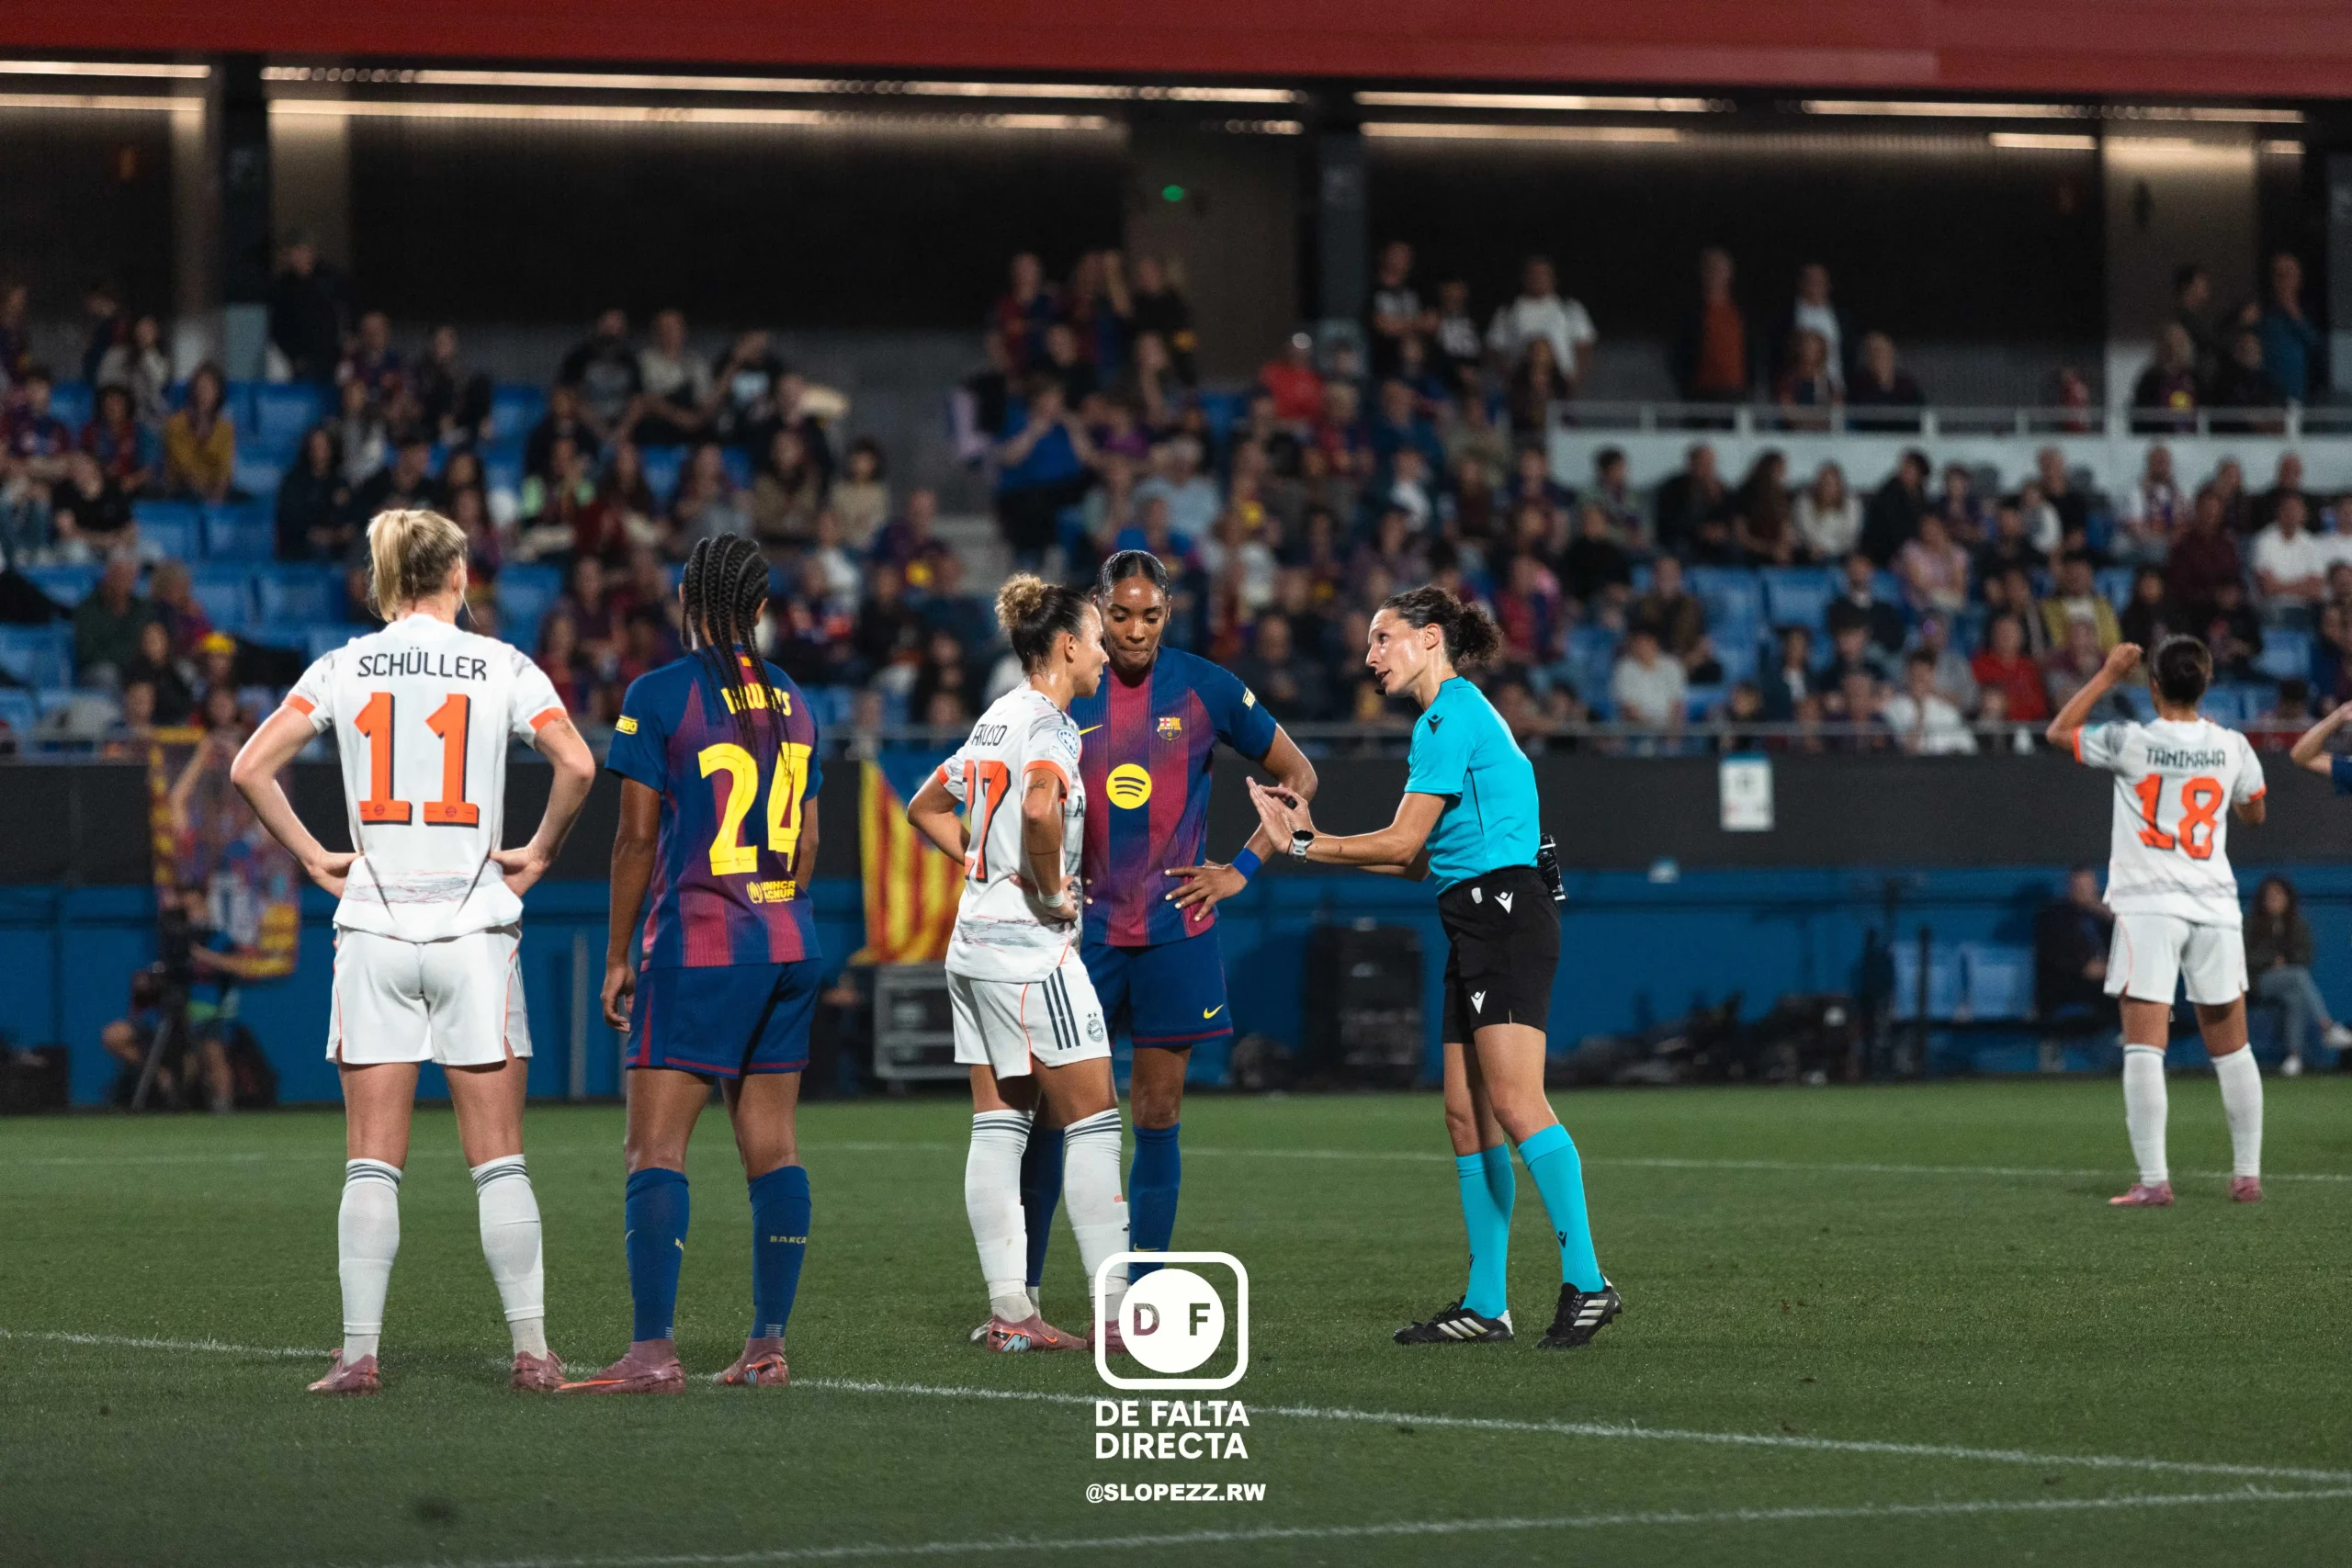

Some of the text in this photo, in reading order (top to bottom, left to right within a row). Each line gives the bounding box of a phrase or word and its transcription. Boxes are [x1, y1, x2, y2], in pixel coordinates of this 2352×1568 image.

[356, 646, 487, 682] SCHÜLLER
[353, 691, 481, 829] 11
[2144, 745, 2226, 769] TANIKAWA
[697, 741, 813, 876] 24
[2133, 773, 2224, 861] 18
[761, 880, 797, 892] UNHCR
[763, 889, 796, 899] ACNUR
